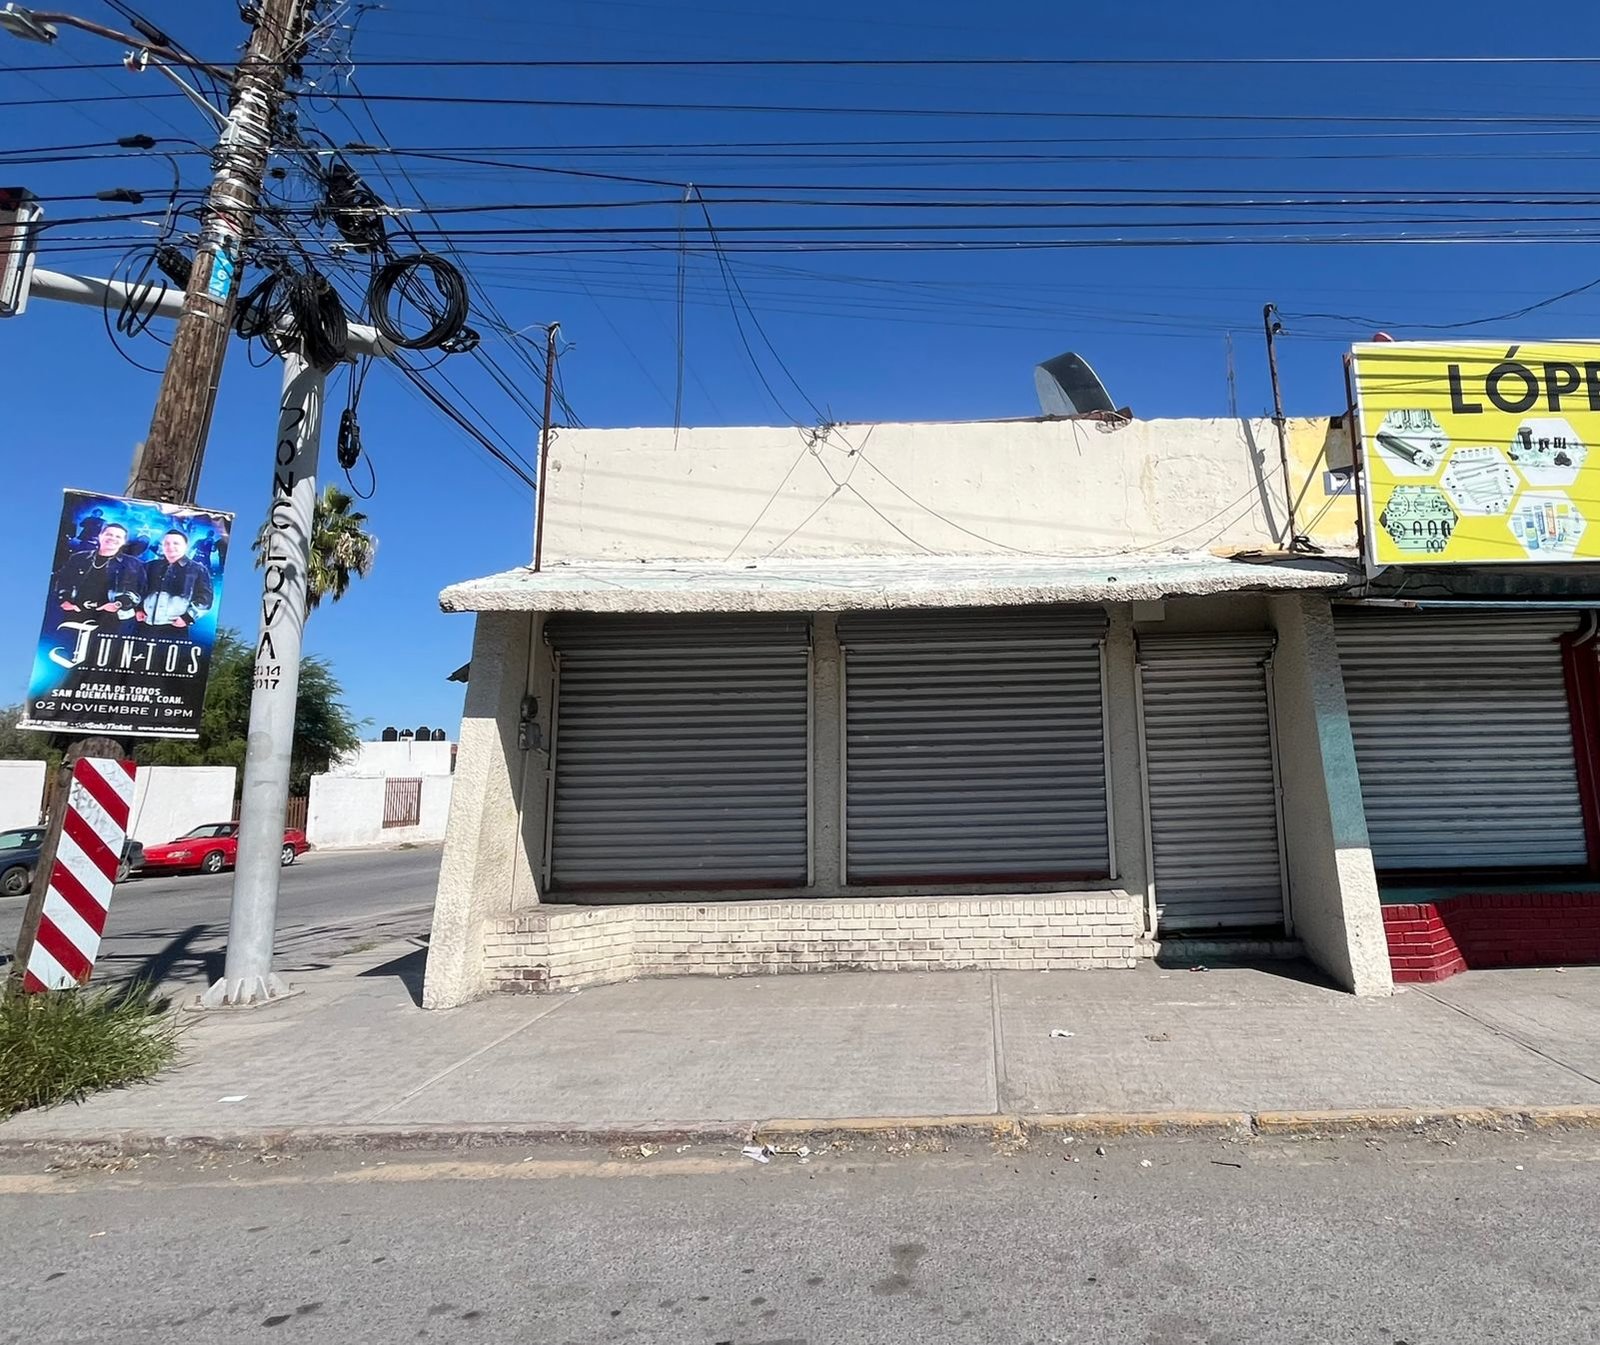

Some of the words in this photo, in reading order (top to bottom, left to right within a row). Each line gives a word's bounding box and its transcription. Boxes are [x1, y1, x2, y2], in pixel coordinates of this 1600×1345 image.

[49, 620, 201, 674] JUNTOS
[51, 689, 72, 698] SAN
[80, 683, 111, 692] PLAZA
[114, 685, 126, 694] DE
[130, 686, 161, 696] TOROS
[35, 700, 56, 711] 02
[60, 702, 149, 715] NOVIEMBRE
[164, 708, 193, 718] 9PM
